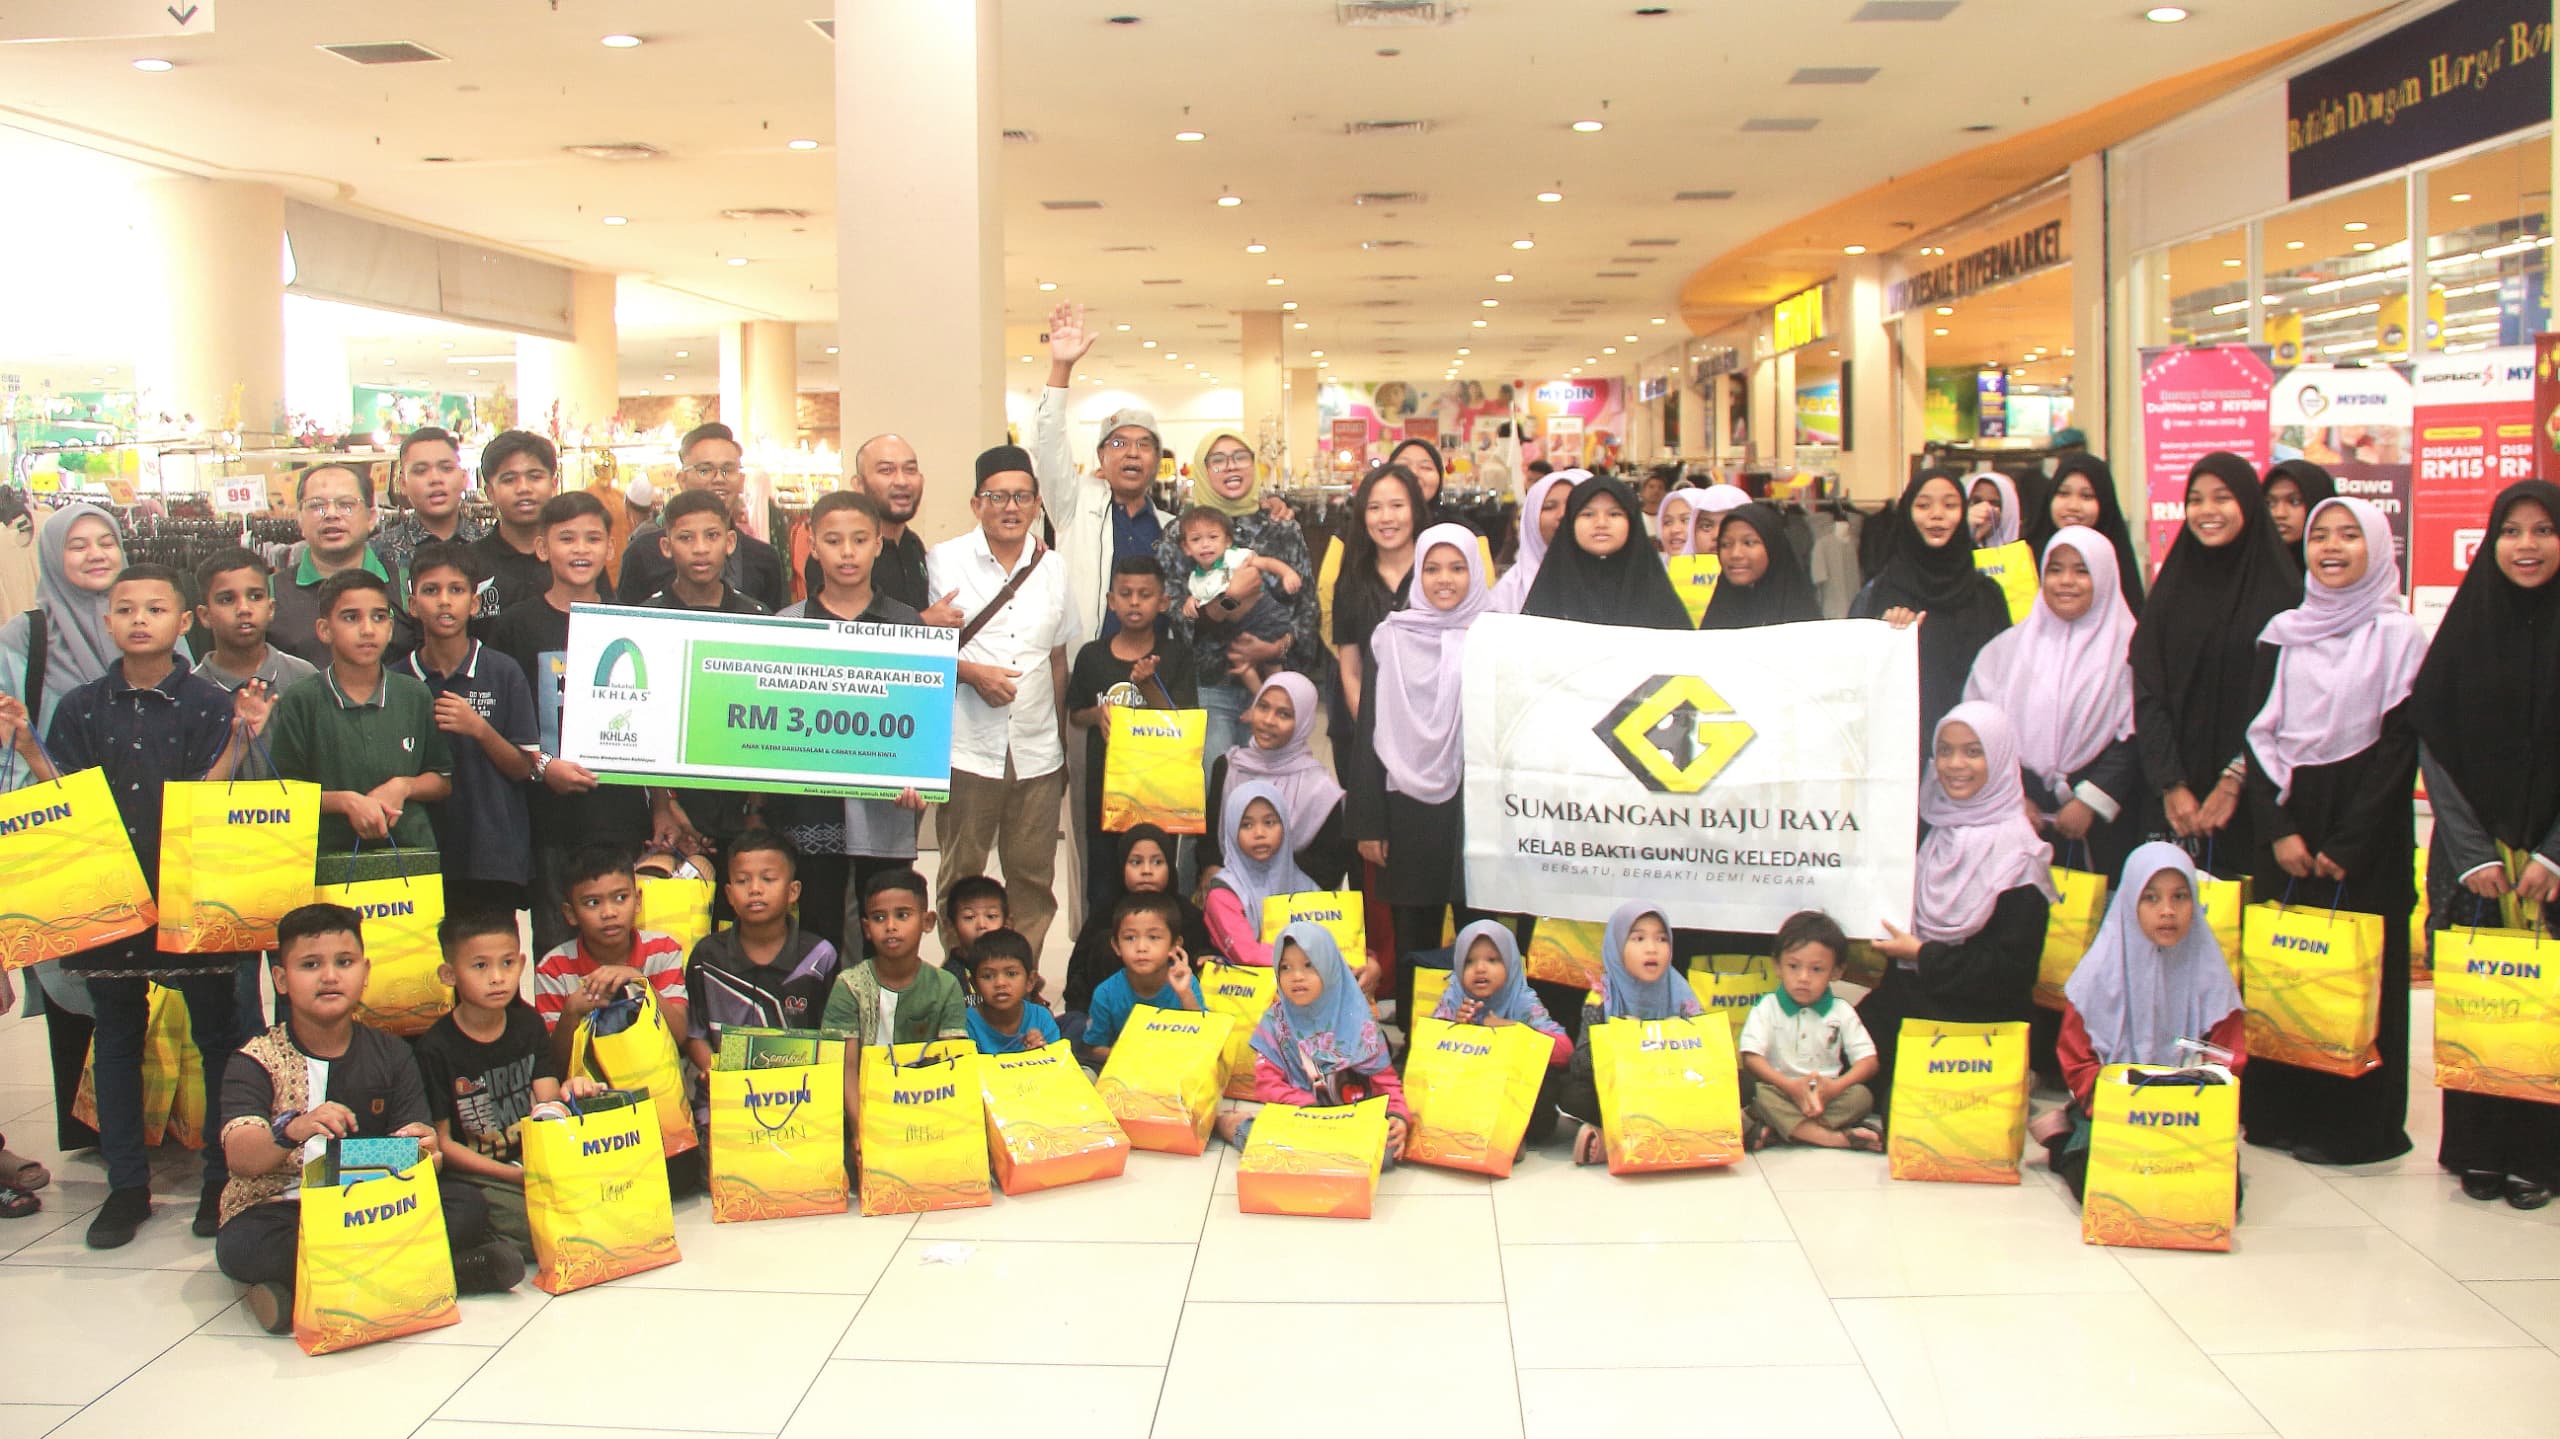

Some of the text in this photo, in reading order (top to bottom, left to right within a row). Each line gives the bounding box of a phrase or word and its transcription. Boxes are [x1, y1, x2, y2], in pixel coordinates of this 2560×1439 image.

[1955, 219, 2061, 300] HYPERMARKET
[2508, 366, 2533, 380] MY
[227, 488, 250, 502] 99
[2334, 477, 2393, 494] Bawa
[836, 621, 954, 641] Takaful IKHLAS
[705, 659, 942, 685] SUMBANGAN IKHLAS BARAKAH BOX
[592, 690, 648, 701] IKHLAS
[759, 677, 887, 695] RAMADAN SYAWAL
[727, 703, 915, 738] RM 3,000.00
[600, 731, 638, 743] IKHLAS
[0, 802, 72, 835] MYDIN
[228, 809, 291, 825] MYDIN
[1505, 793, 1860, 833] SUMBANGAN BAJU RAYA
[1518, 838, 1841, 868] KELAB BAKTI GUNUNG KELEDANG
[1623, 866, 1698, 881] BERBAKTI
[1706, 871, 1744, 883] DEMI
[1752, 874, 1815, 886] NEGARA
[1290, 910, 1342, 924] MYDIN
[2272, 934, 2329, 955] MYDIN
[2467, 959, 2541, 979] MYDIN
[1217, 984, 1256, 998] MYDIN
[1146, 1022, 1200, 1034] MYDIN
[1436, 1040, 1491, 1056] MYDIN
[1000, 1057, 1056, 1069] MYDIN
[1928, 1059, 1993, 1073] MYDIN
[744, 1088, 811, 1108] MYDIN
[893, 1084, 956, 1105] MYDIN
[2128, 1111, 2200, 1127] MYDIN
[583, 1129, 641, 1157] MYDIN
[343, 1192, 417, 1228] MYDIN
